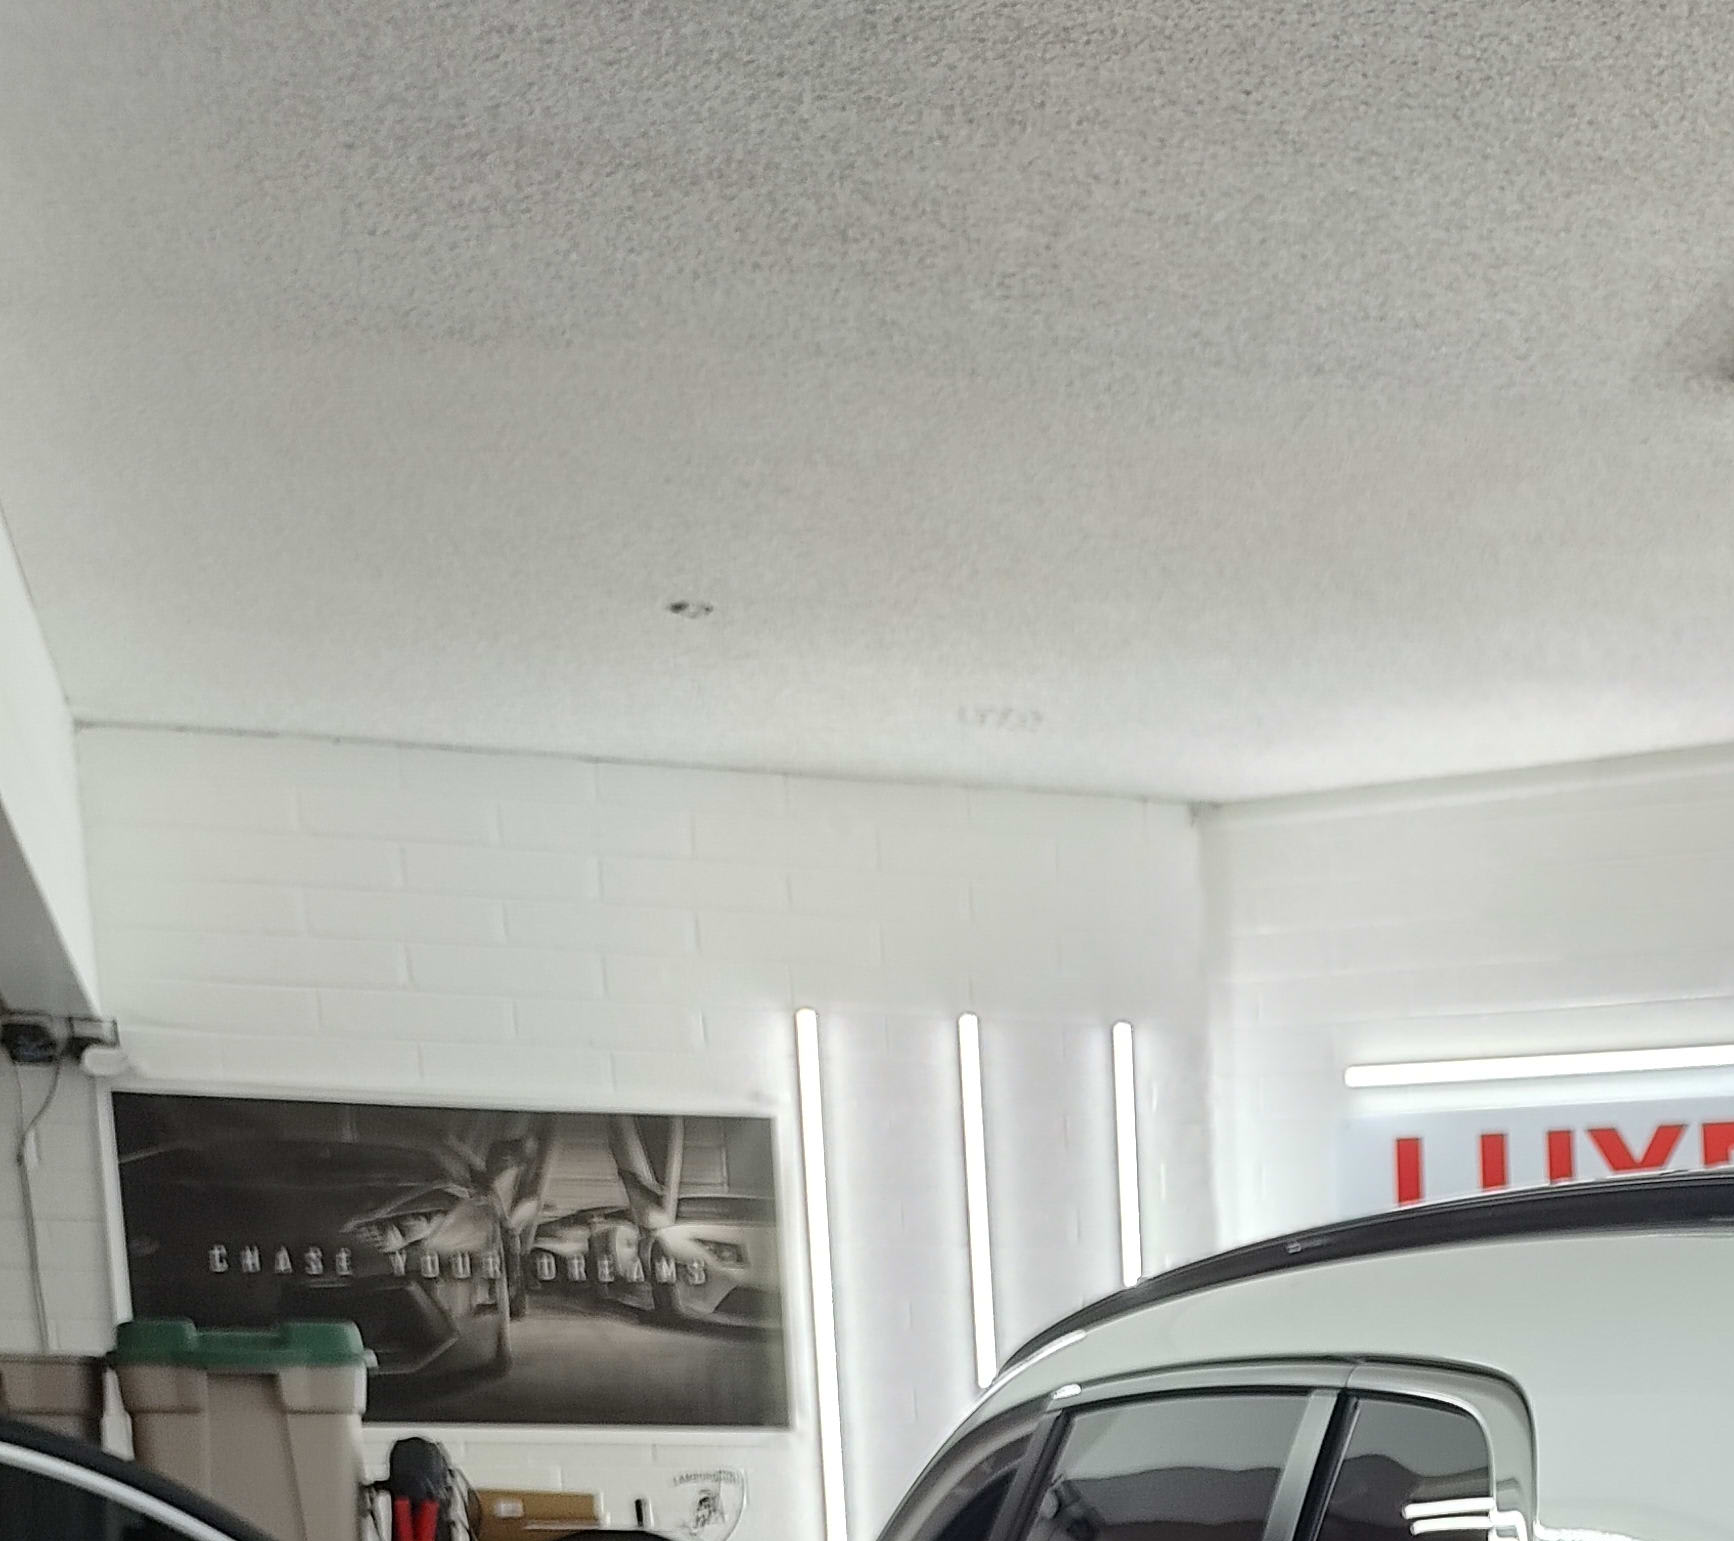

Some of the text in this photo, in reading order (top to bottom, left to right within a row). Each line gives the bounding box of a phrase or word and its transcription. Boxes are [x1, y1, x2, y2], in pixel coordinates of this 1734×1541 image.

[209, 1244, 706, 1285] CHASE YOUR DREAMS
